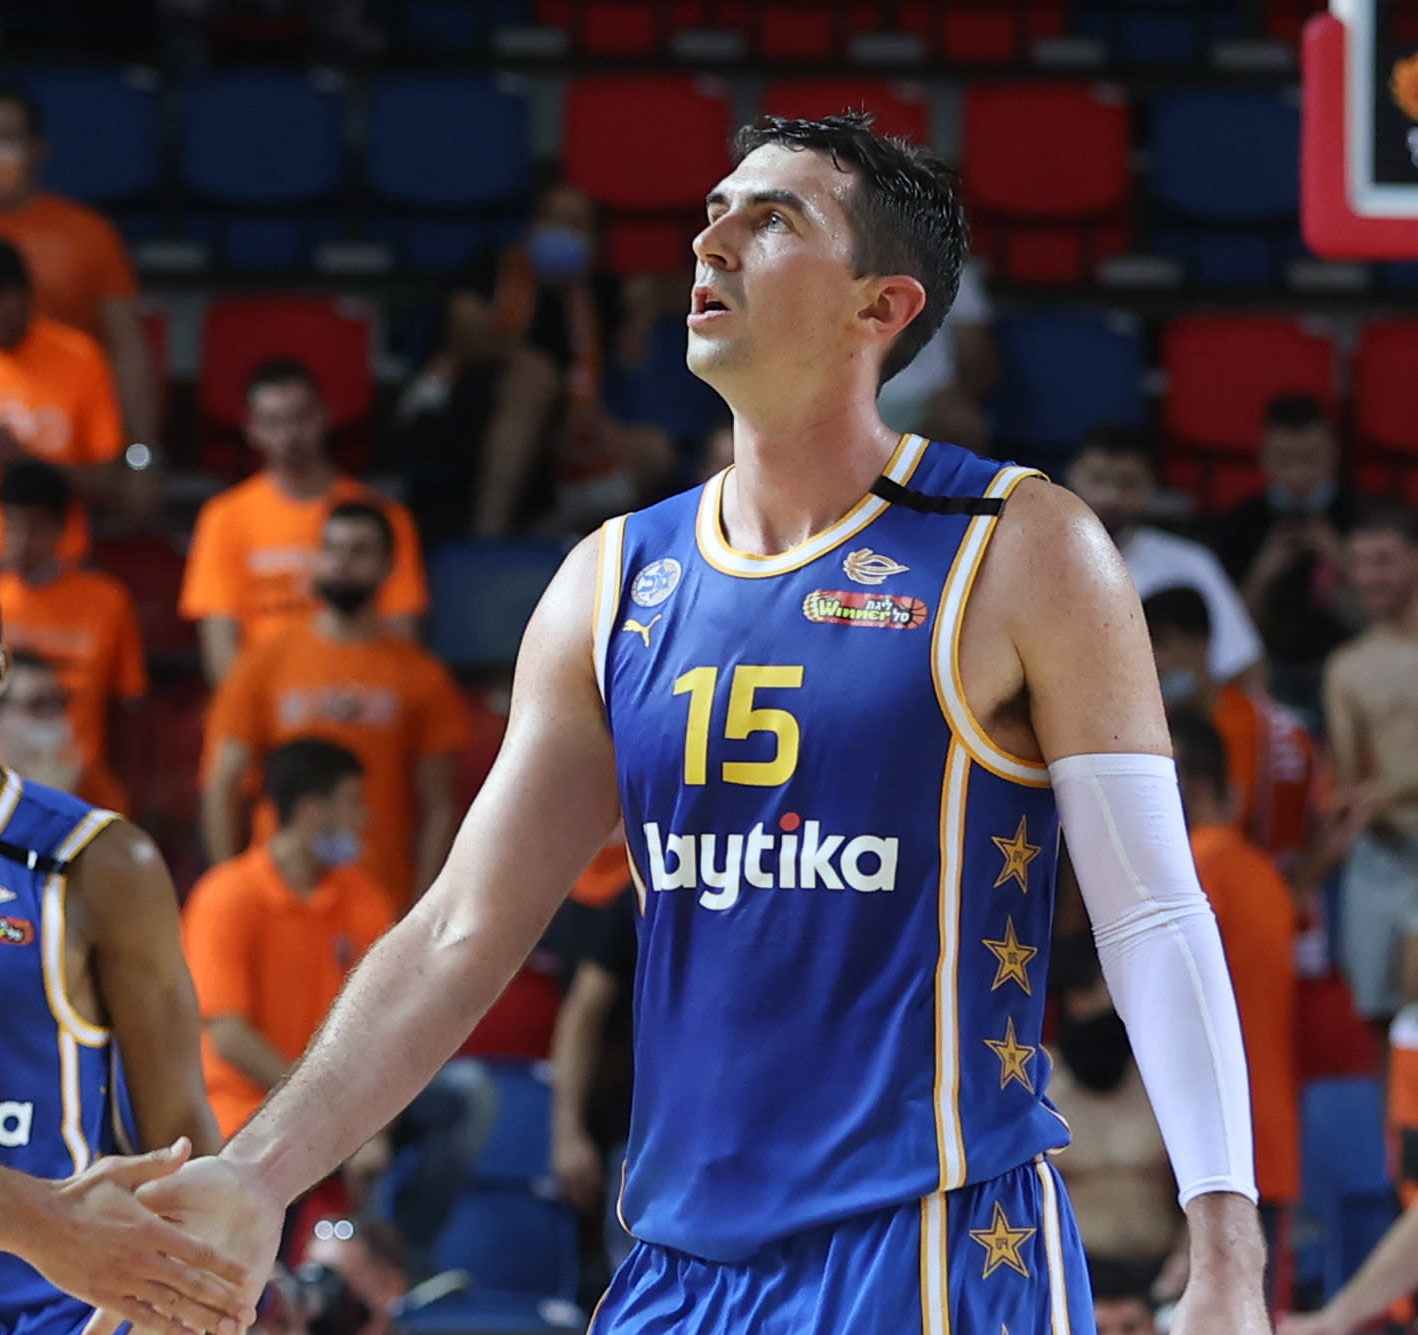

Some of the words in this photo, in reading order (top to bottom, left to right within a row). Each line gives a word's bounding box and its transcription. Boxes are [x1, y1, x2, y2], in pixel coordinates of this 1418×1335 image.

[817, 597, 891, 621] Winner
[671, 665, 804, 787] 15
[643, 812, 899, 911] laytika
